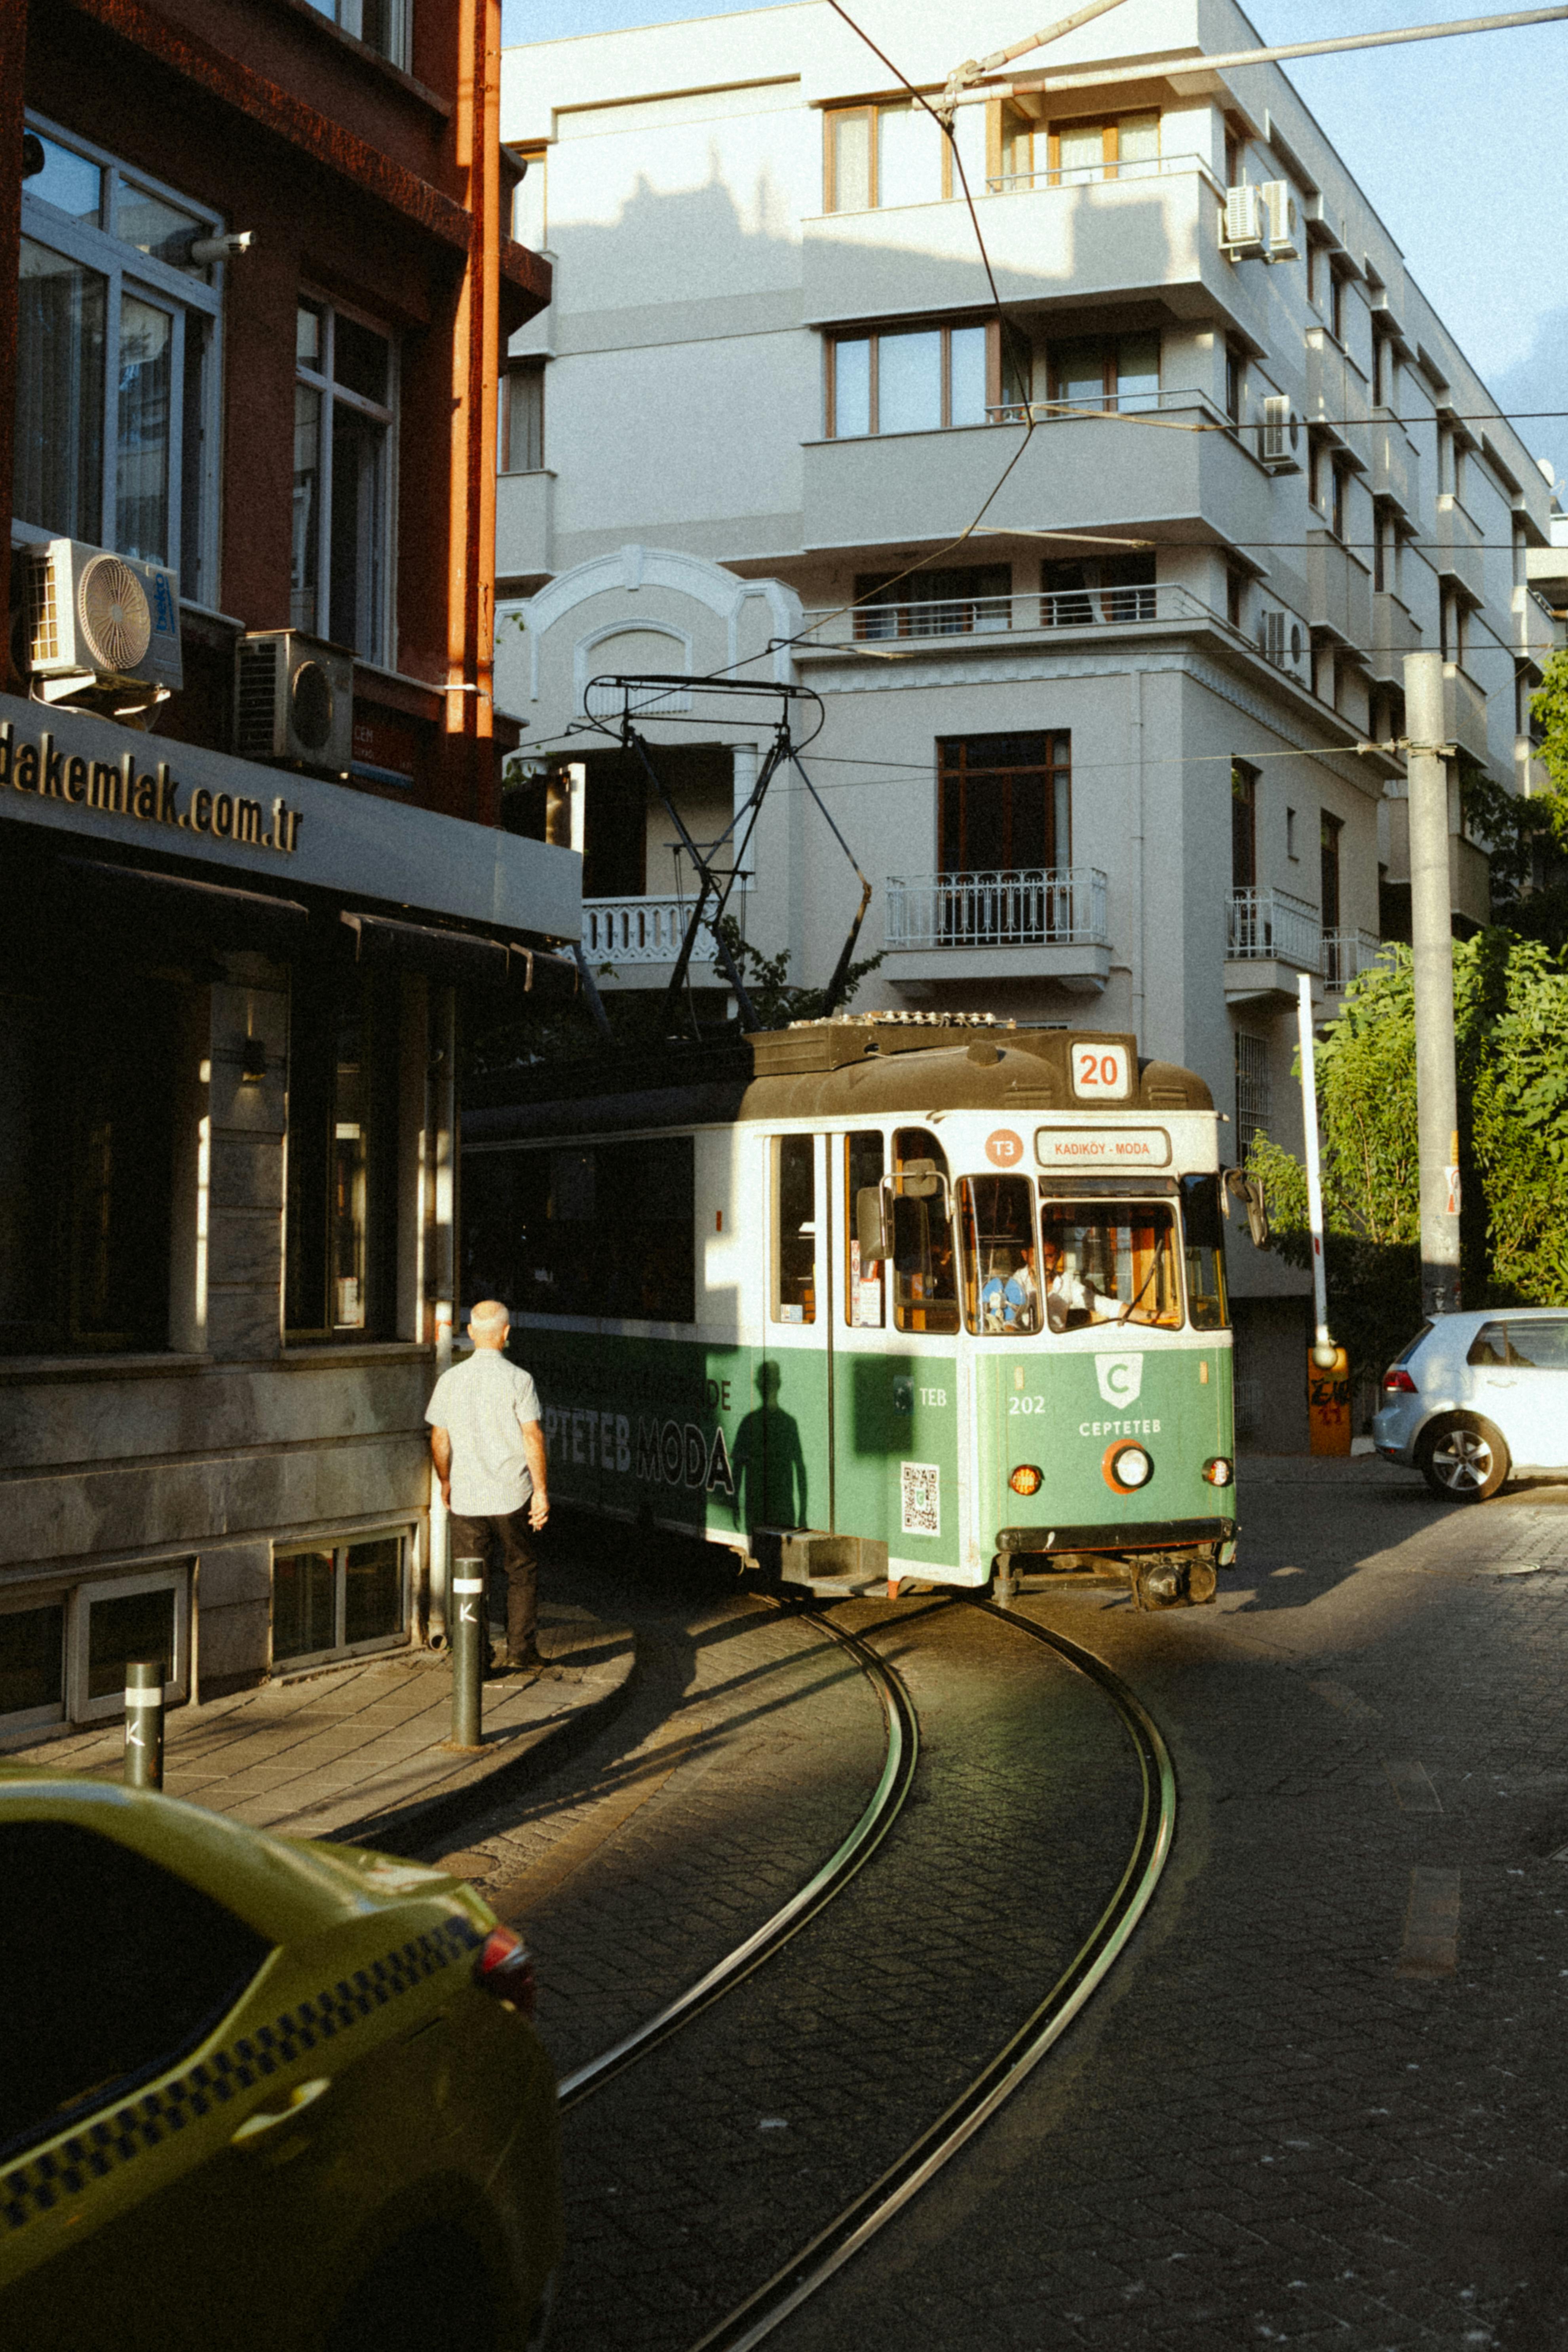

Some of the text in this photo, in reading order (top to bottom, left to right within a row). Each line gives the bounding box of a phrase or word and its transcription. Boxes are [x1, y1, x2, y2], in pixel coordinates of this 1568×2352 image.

[154, 573, 167, 631] beko
[1080, 1055, 1118, 1085] 20
[992, 1140, 1014, 1156] T3
[1055, 1142, 1105, 1155] KADIKÖY
[1116, 1144, 1150, 1154] MODA
[919, 1388, 947, 1406] TEB
[1009, 1396, 1046, 1415] 202
[1079, 1419, 1161, 1436] CEPTETEB
[637, 1415, 735, 1495] MODA
